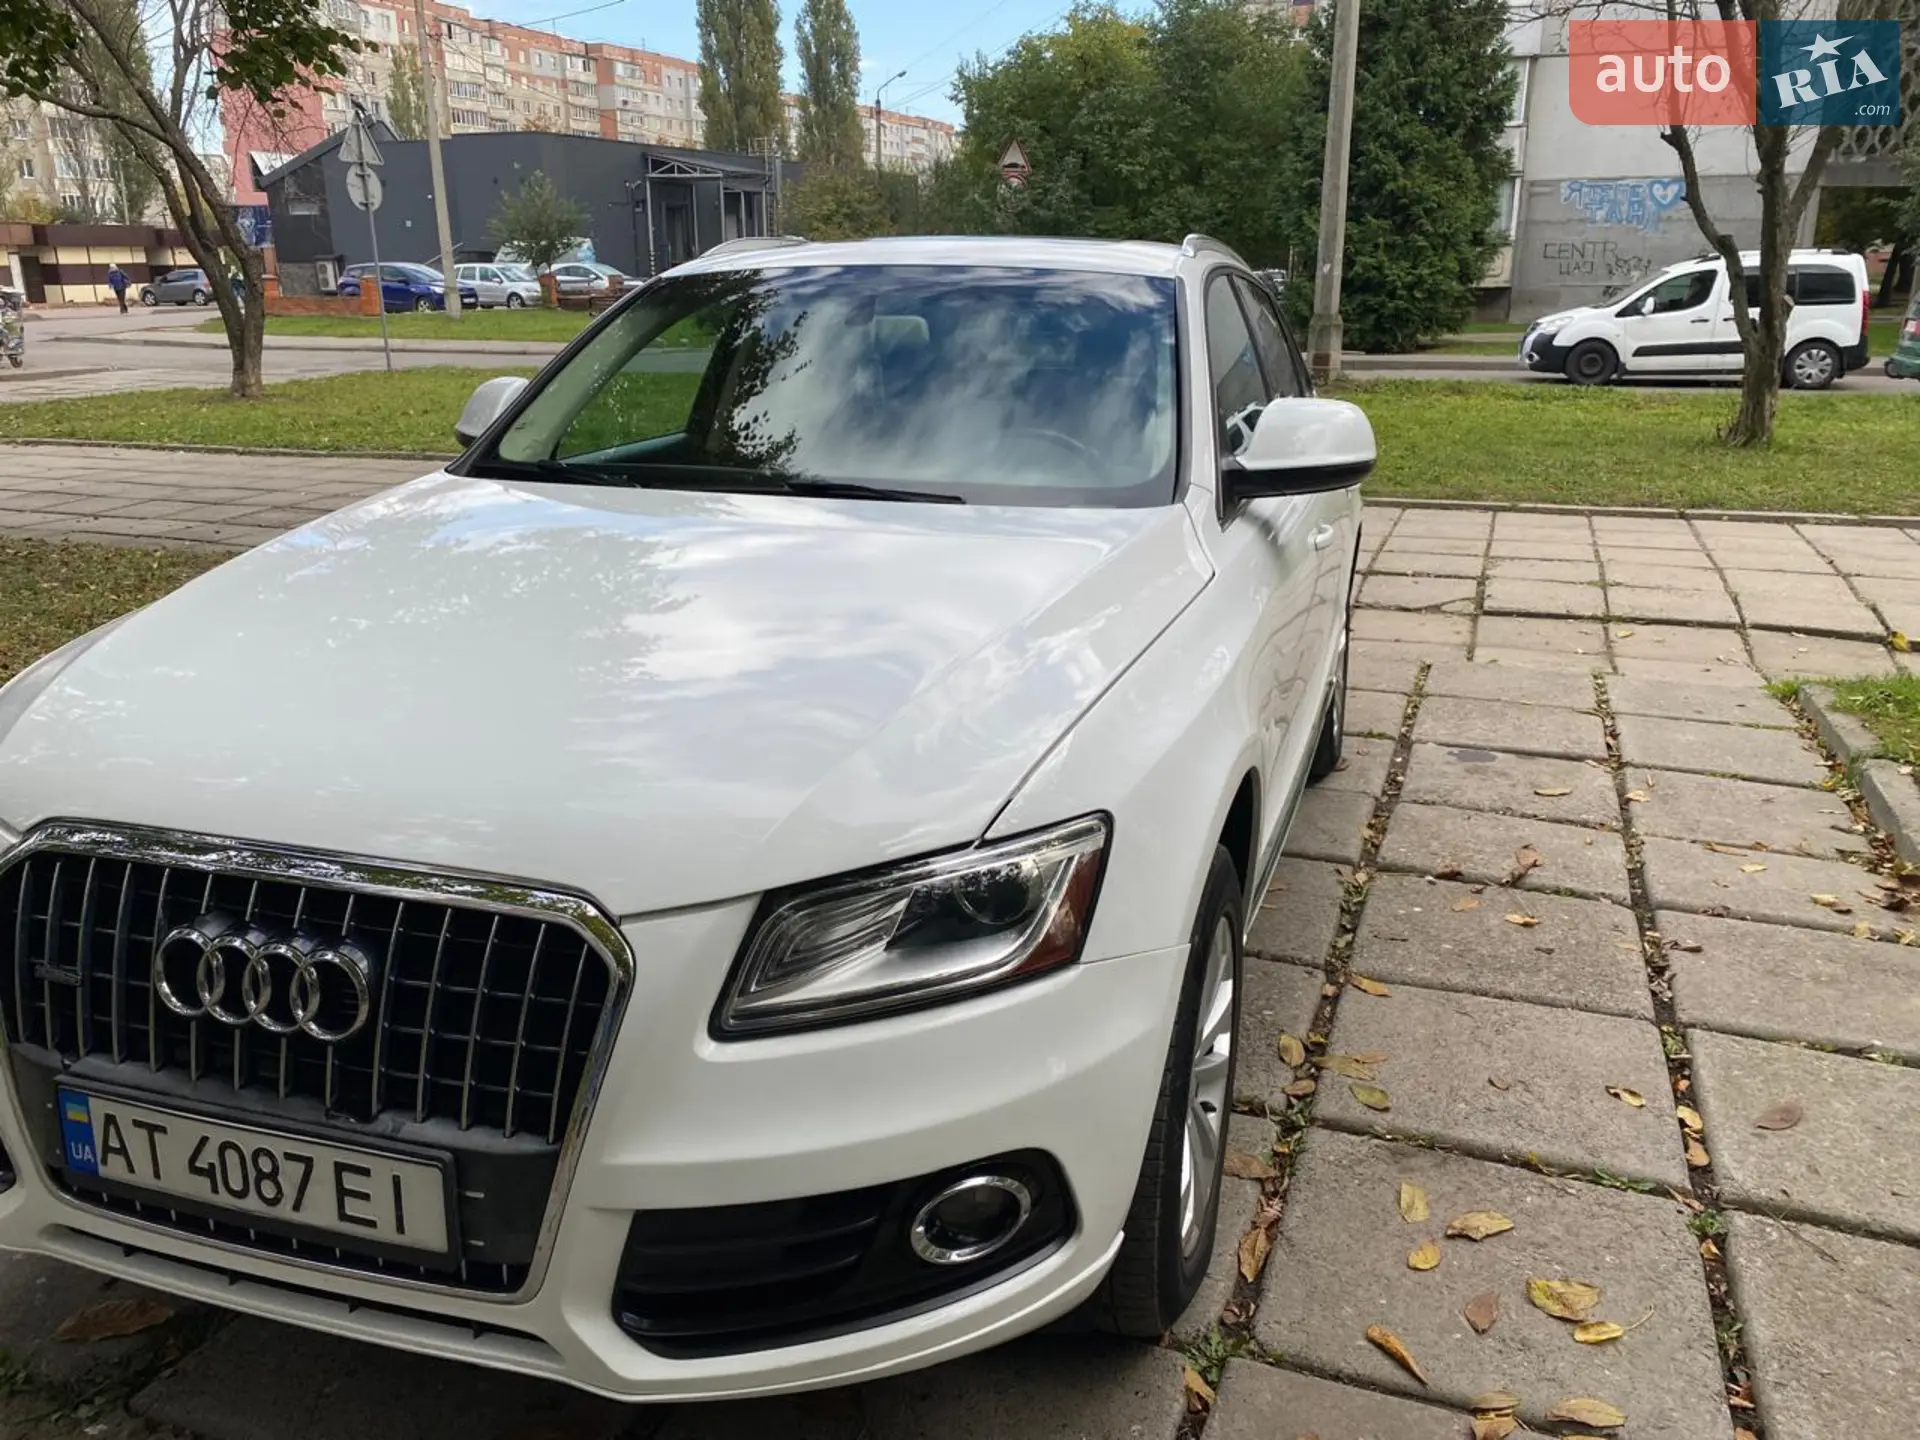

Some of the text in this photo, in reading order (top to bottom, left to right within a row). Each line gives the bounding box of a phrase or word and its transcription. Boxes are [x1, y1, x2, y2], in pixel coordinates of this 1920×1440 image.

[70, 1140, 96, 1165] UA
[99, 1112, 406, 1236] AT 4087 EI
